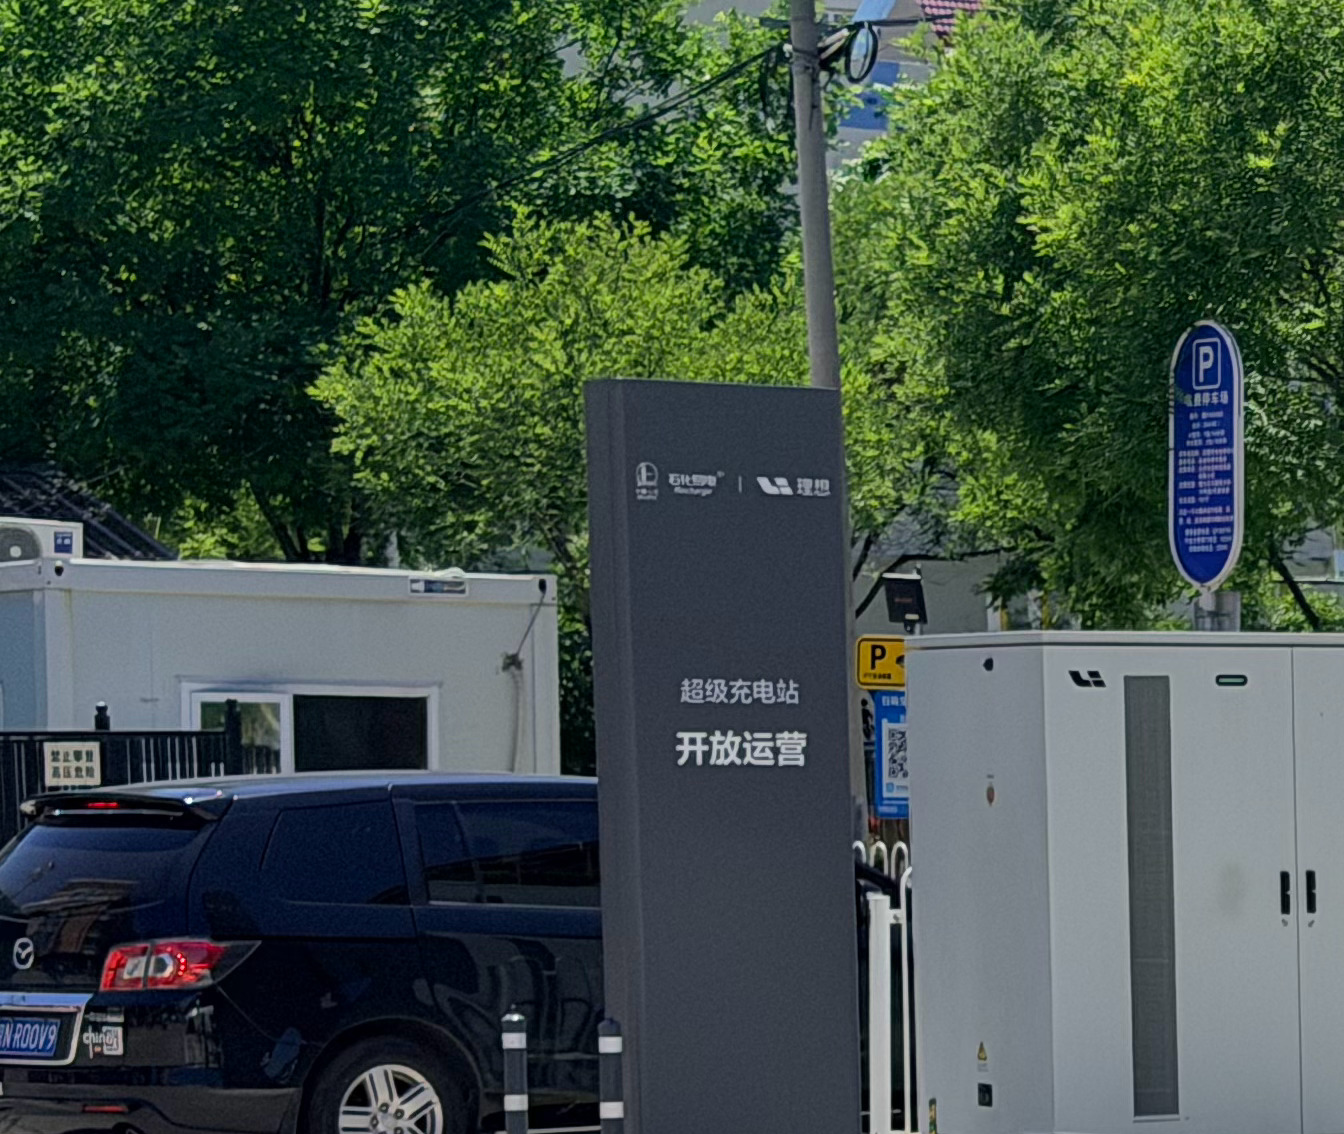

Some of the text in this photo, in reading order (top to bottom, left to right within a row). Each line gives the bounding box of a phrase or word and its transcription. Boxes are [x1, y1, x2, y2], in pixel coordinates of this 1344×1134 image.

[1200, 346, 1214, 383] P
[871, 644, 887, 670] P
[680, 678, 800, 705] 超级充电站
[675, 730, 808, 767] 开放运营
